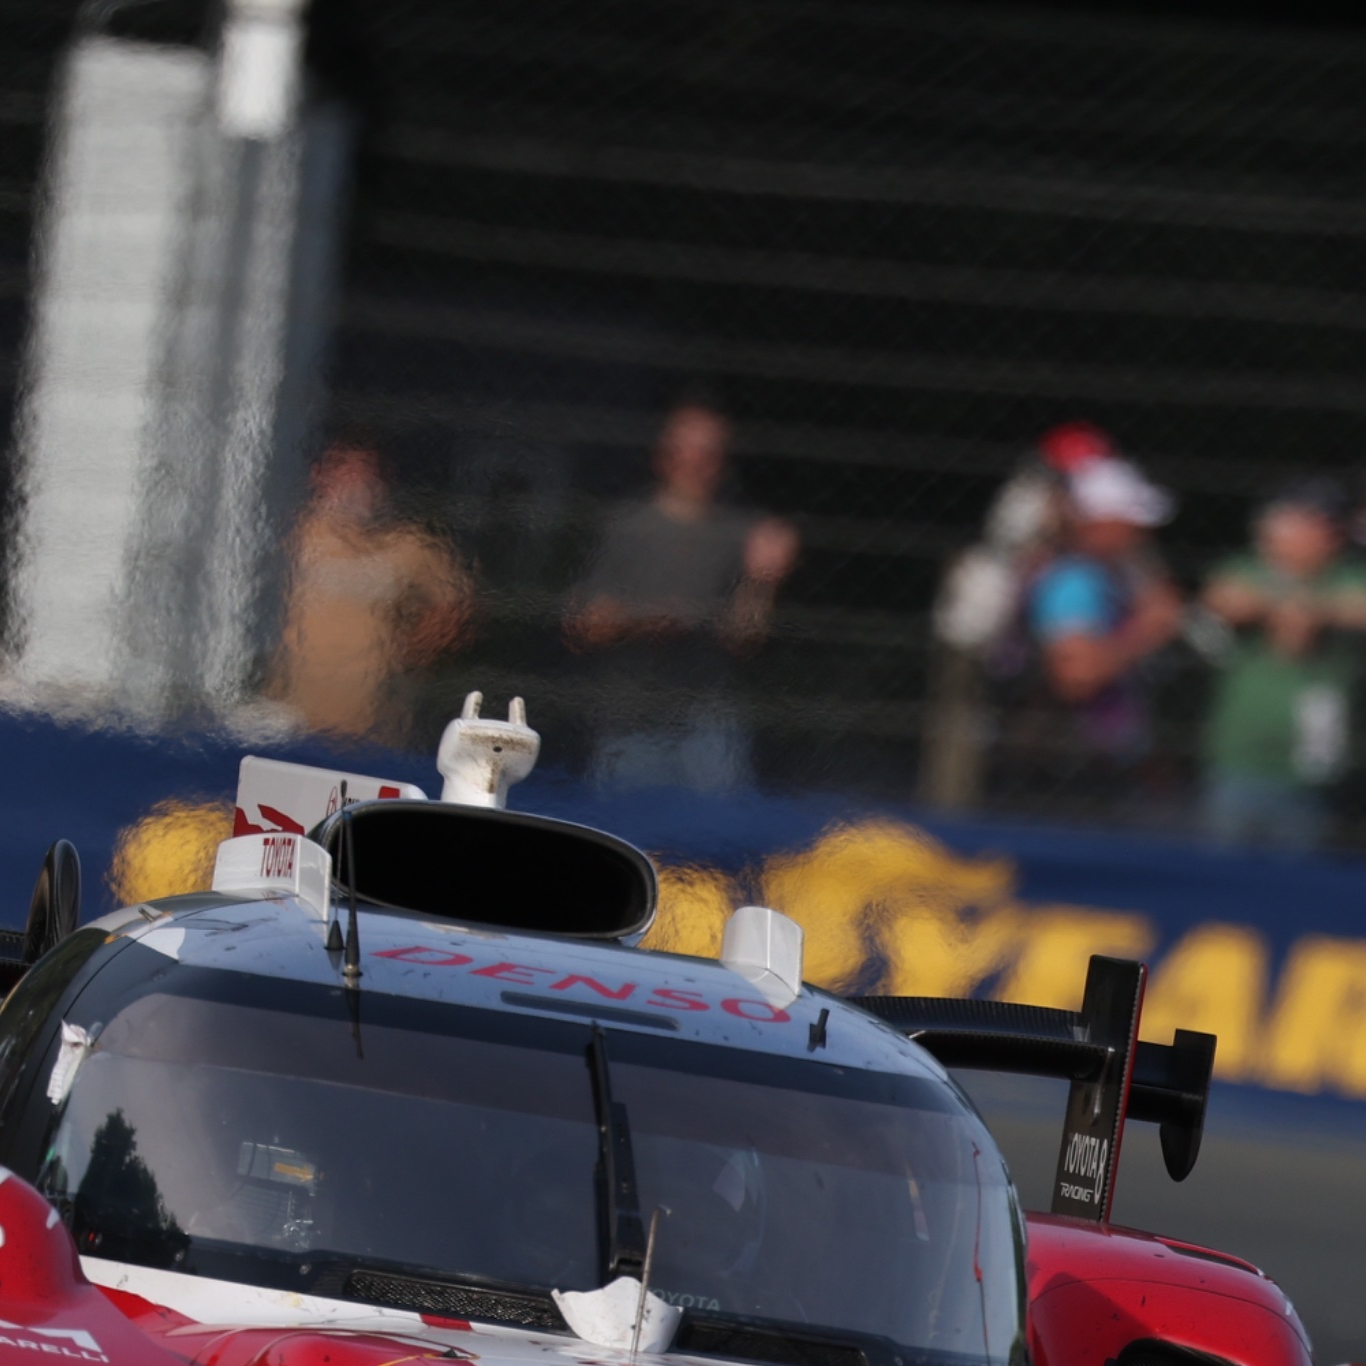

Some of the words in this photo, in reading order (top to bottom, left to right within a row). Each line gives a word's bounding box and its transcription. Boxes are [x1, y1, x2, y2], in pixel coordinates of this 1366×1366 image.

[260, 836, 295, 879] TOYOTA
[368, 946, 792, 1024] DENSO
[1063, 1132, 1100, 1179] TOYOTA
[1094, 1138, 1109, 1205] 8
[1060, 1181, 1094, 1203] RACING
[648, 1286, 721, 1312] OYOTA
